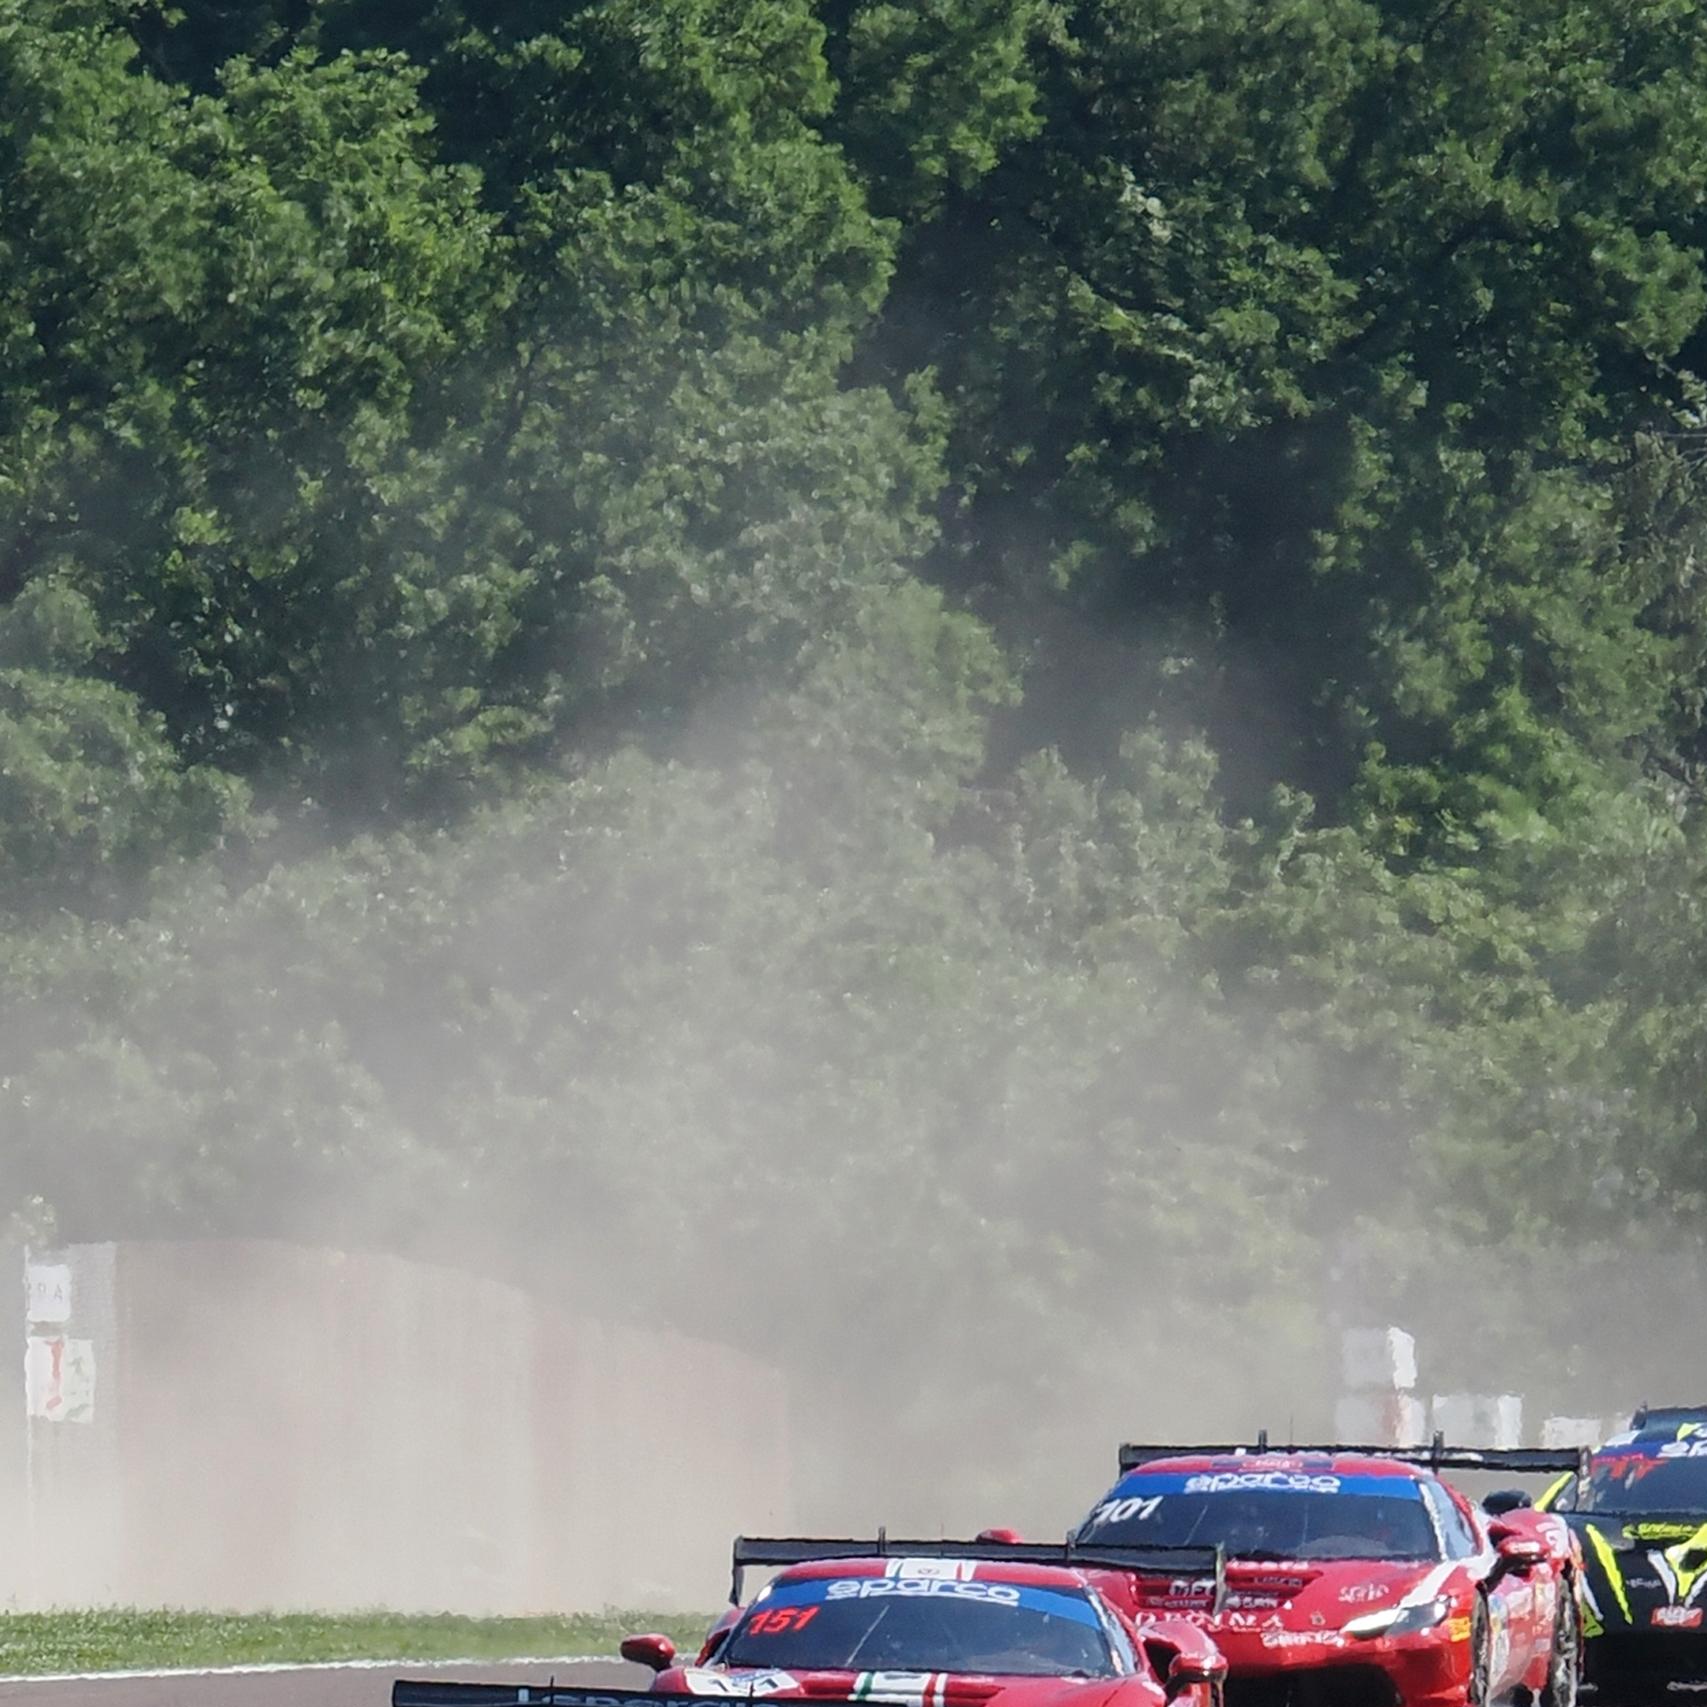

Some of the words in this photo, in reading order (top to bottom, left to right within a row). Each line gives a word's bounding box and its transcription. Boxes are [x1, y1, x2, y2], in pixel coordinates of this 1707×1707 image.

[1096, 1496, 1164, 1523] 101
[825, 1577, 1021, 1607] sparco
[748, 1605, 821, 1635] 151
